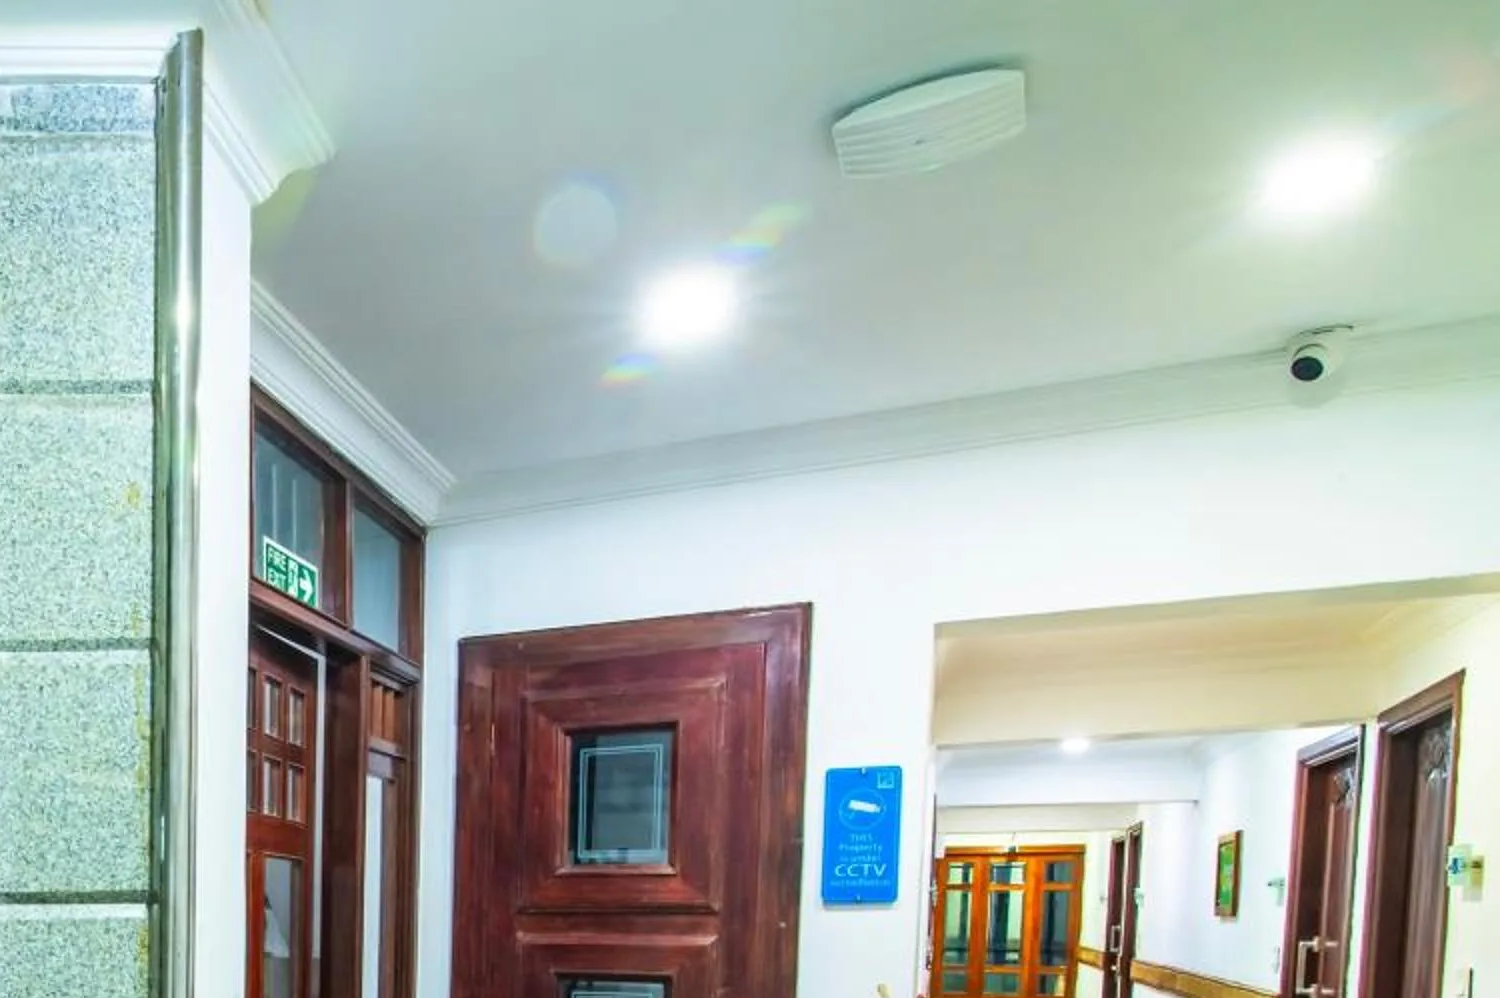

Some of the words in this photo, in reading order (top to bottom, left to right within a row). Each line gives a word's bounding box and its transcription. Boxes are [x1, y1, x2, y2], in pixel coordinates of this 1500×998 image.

[267, 546, 288, 574] FIRE
[267, 566, 288, 593] EXIT
[834, 863, 888, 878] CCTV
